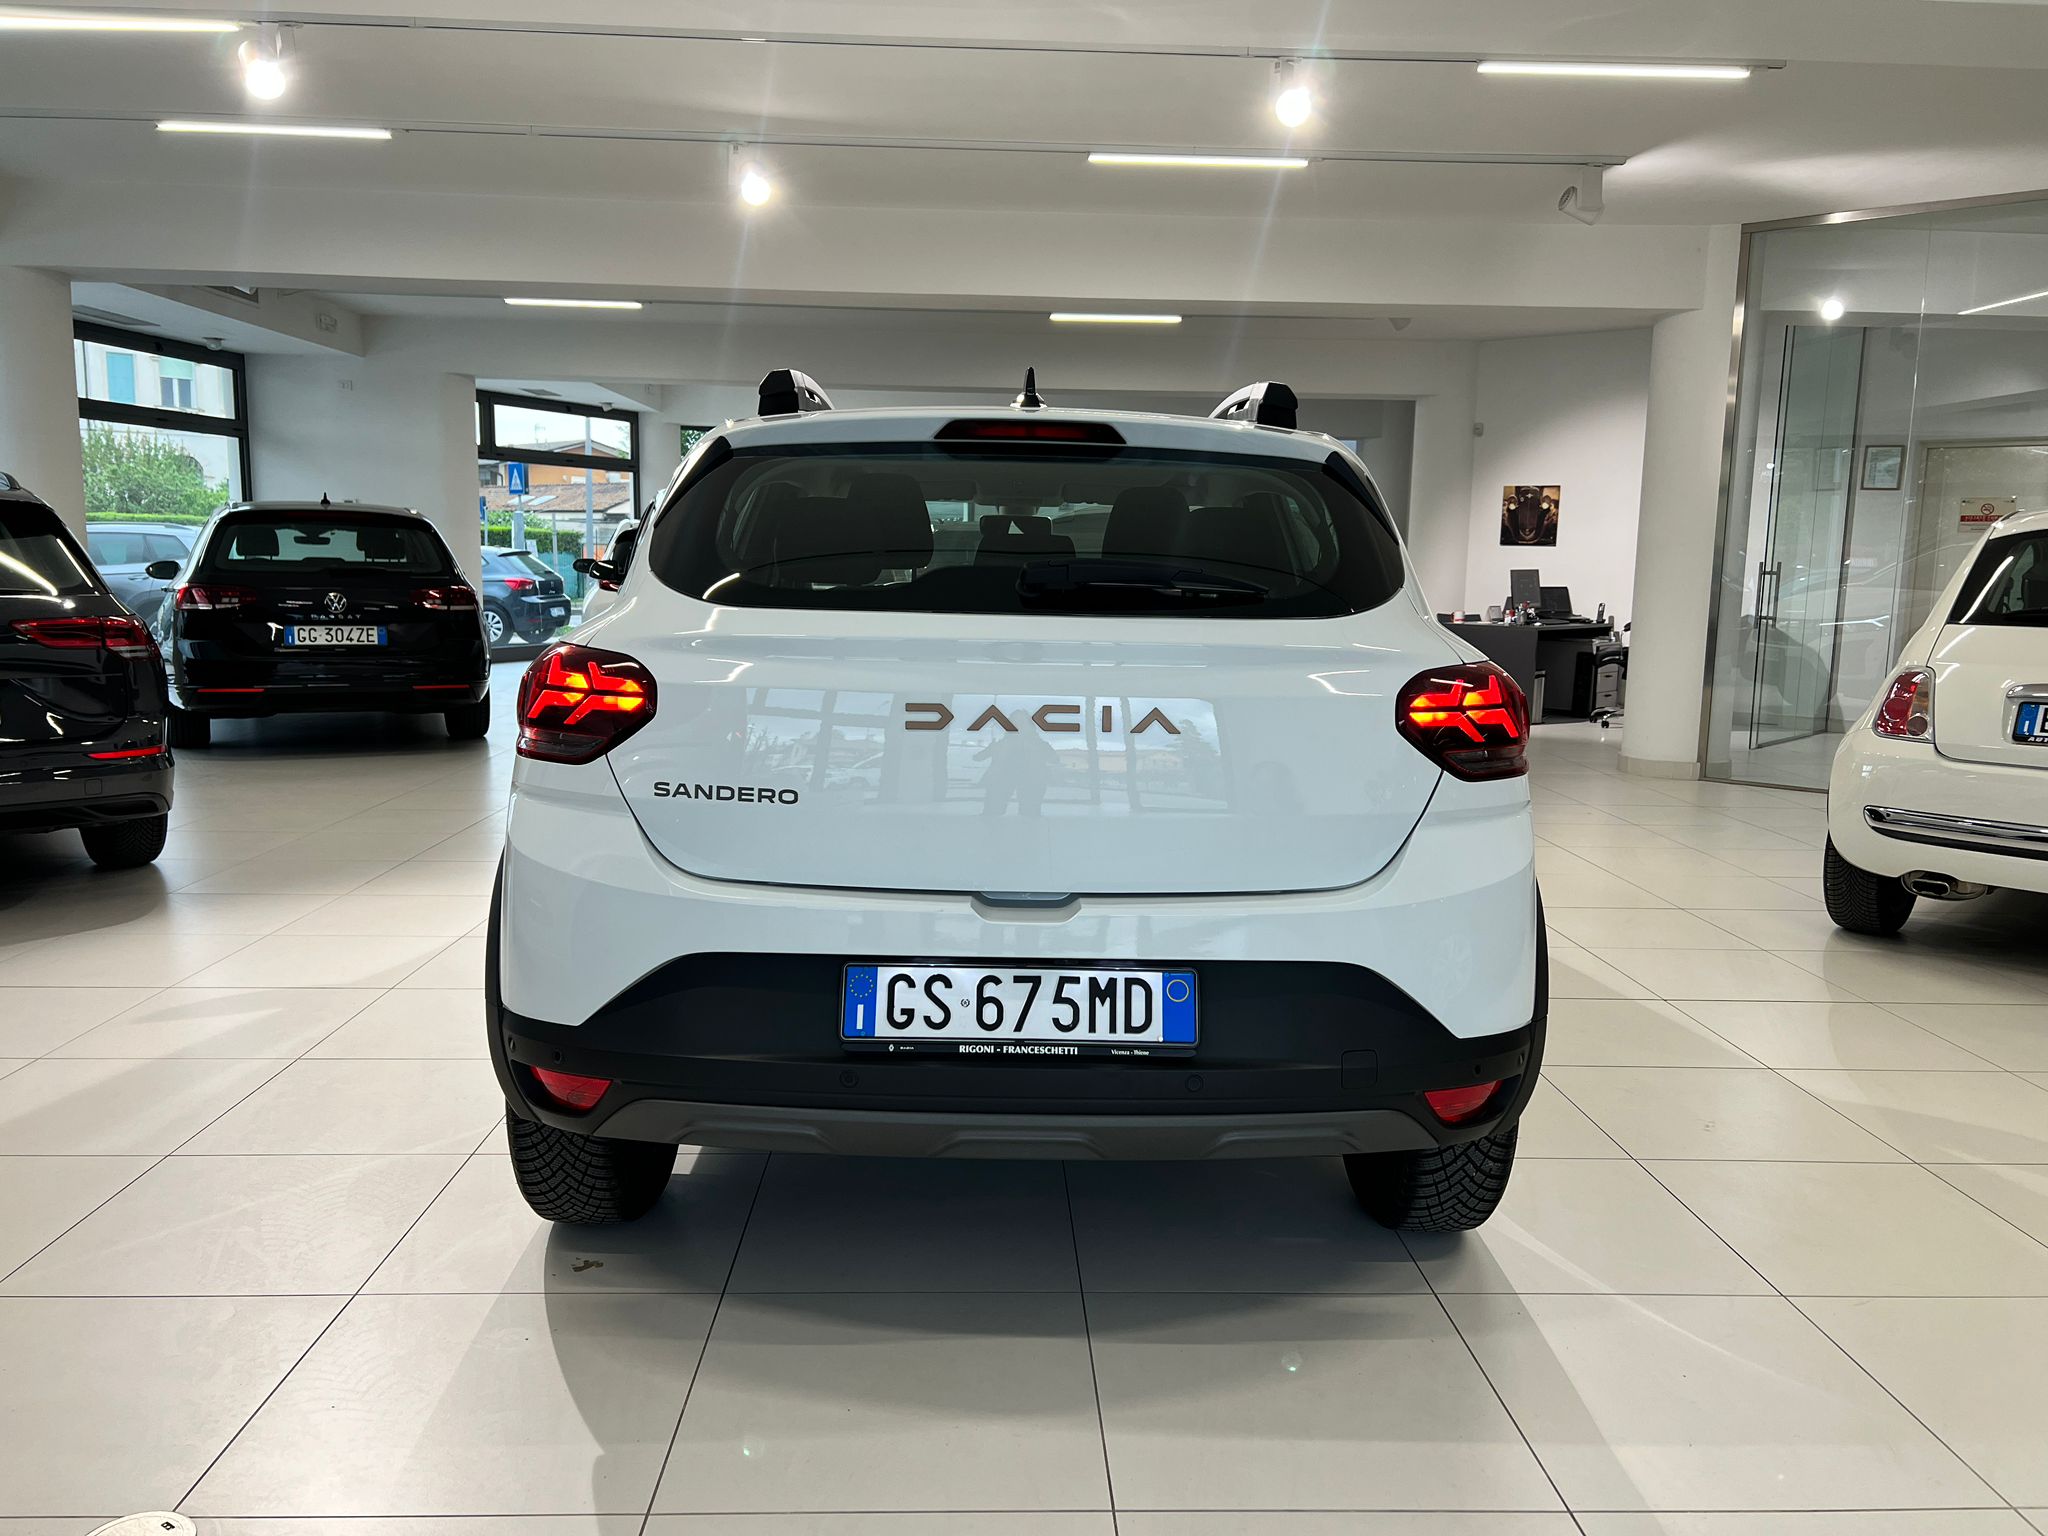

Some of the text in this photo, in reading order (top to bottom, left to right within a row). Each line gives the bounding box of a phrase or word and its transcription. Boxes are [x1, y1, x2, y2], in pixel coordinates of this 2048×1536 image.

[297, 627, 319, 643] GG
[324, 627, 376, 643] 304ZE
[904, 702, 1181, 735] DACIA
[653, 781, 799, 805] SANDERO
[886, 973, 953, 1031] GS
[975, 974, 1154, 1034] 675MD
[959, 1044, 995, 1054] RIGONI
[1002, 1045, 1079, 1055] FRANCESCHETTI
